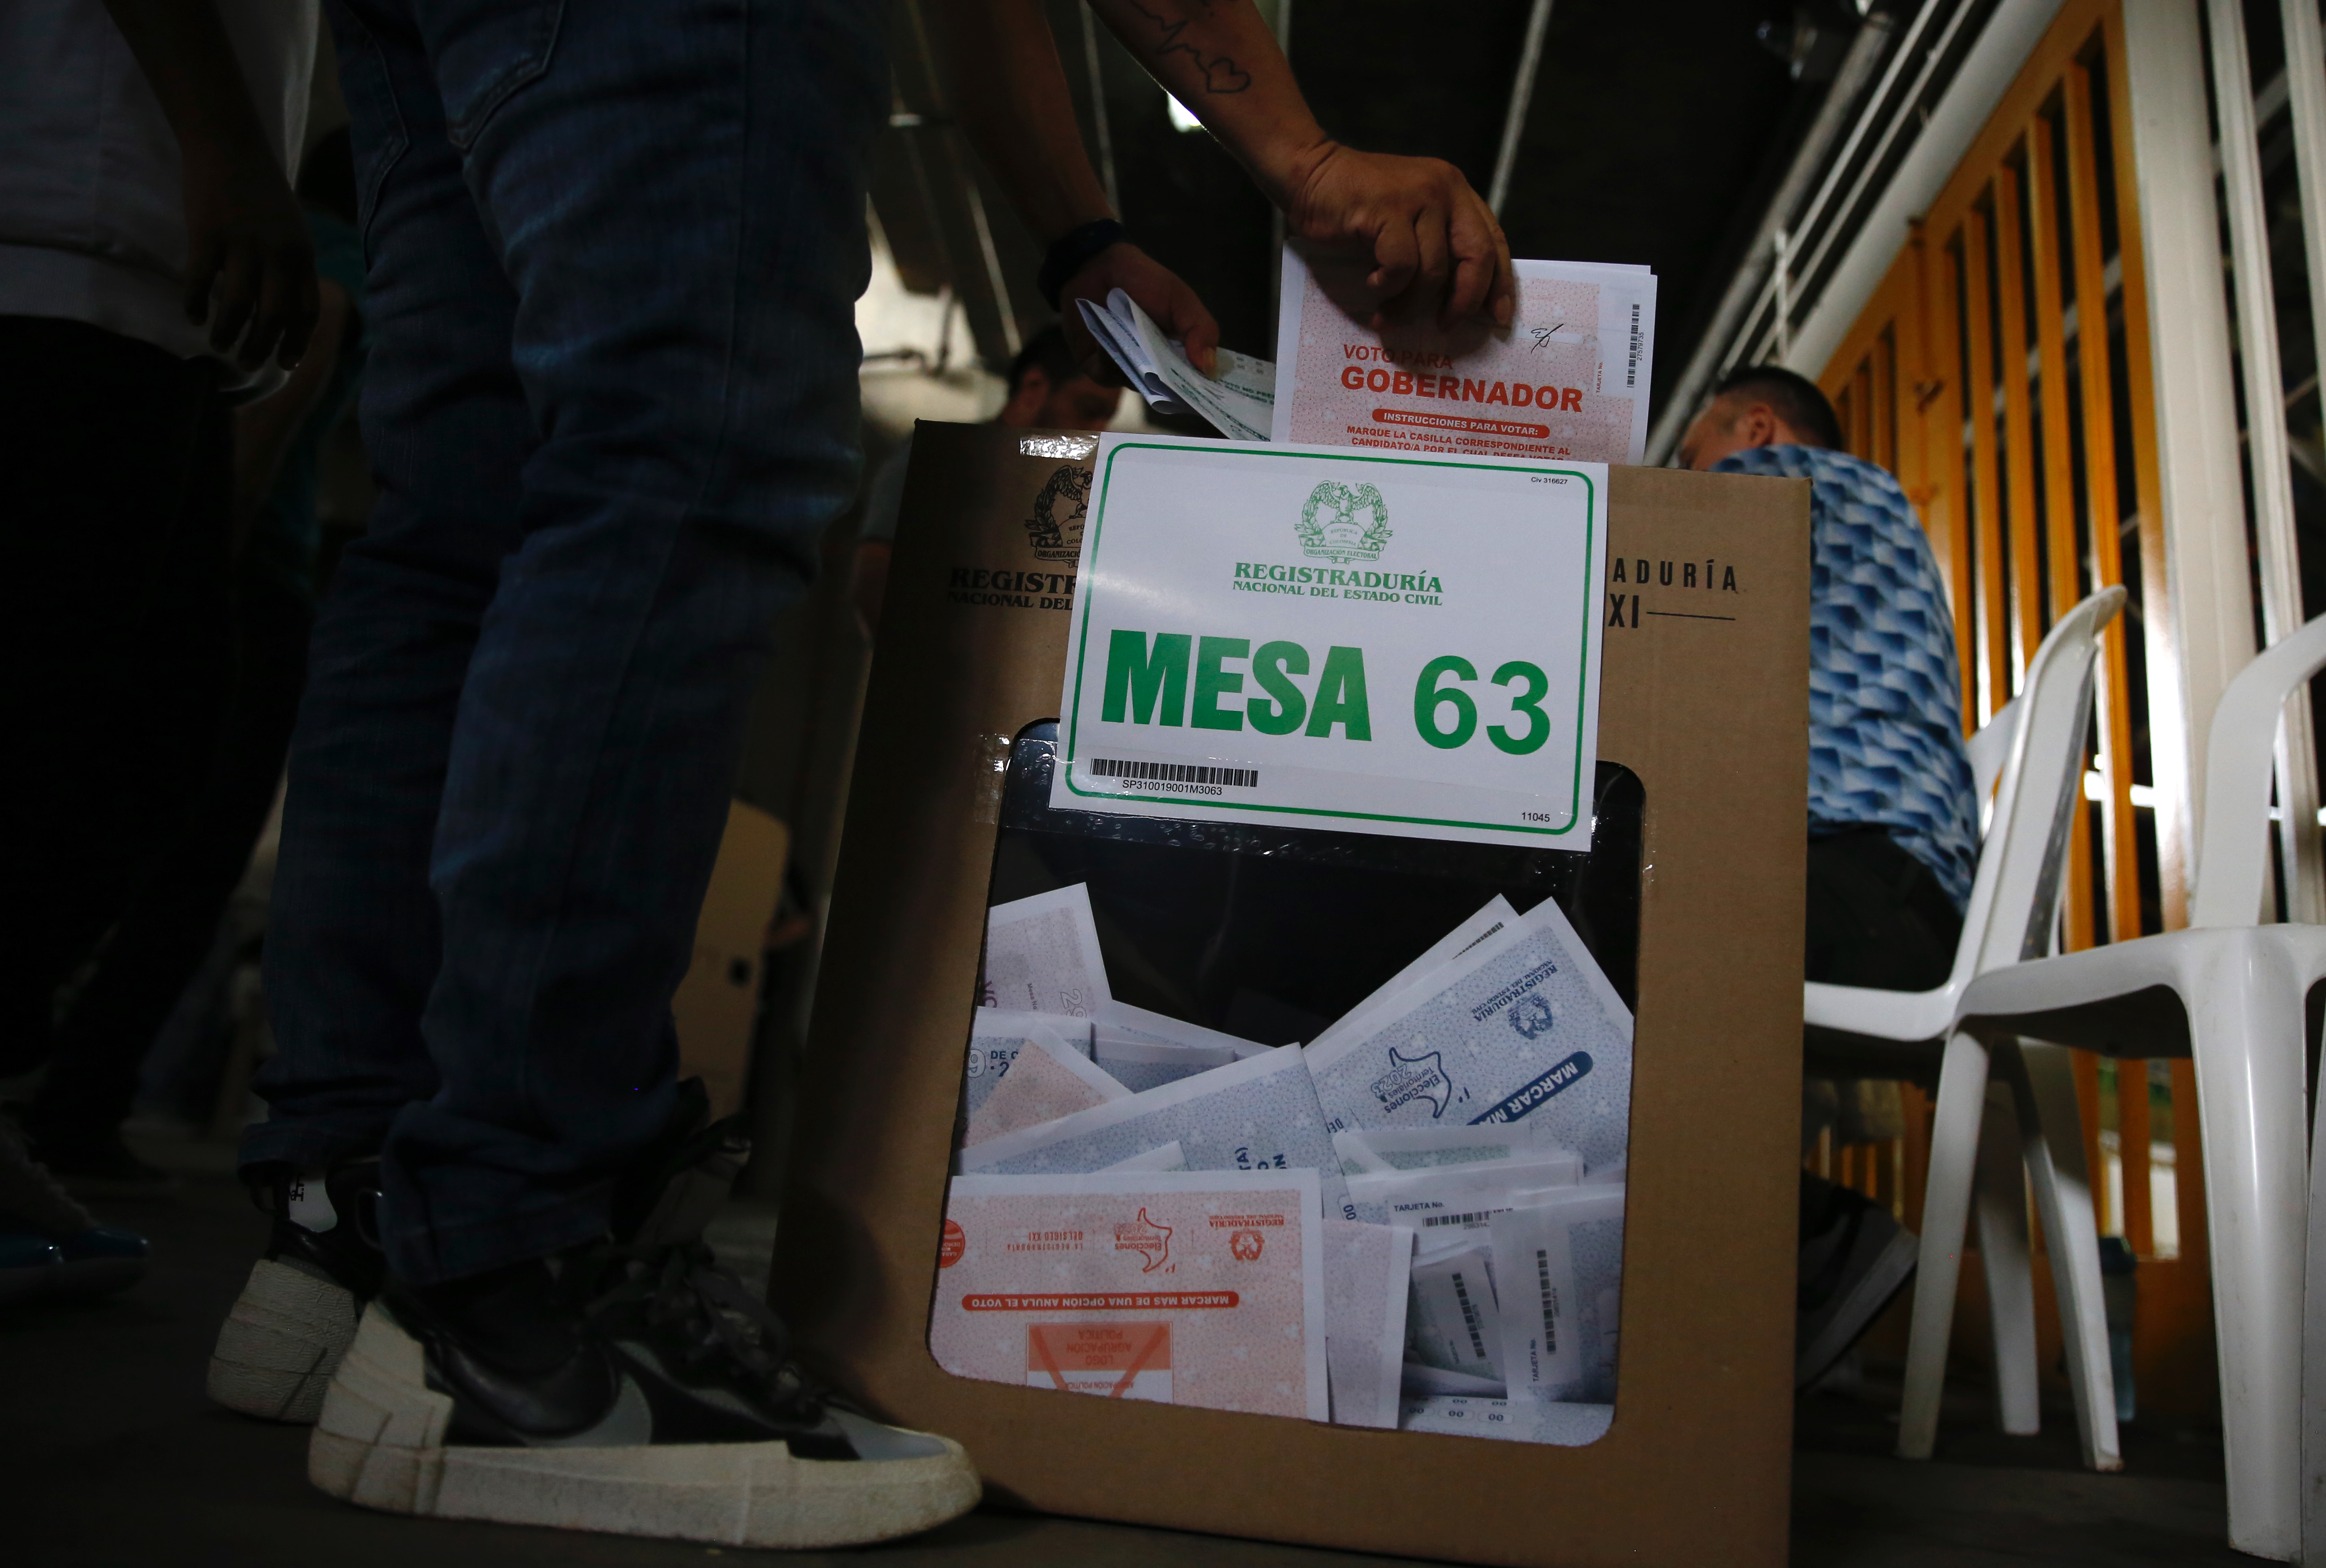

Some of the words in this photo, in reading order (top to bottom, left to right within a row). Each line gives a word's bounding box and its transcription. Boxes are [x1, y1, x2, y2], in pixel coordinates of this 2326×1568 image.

[1344, 344, 1392, 364] VOTO
[1401, 350, 1453, 370] PARA
[1341, 366, 1582, 413] GOBERNADOR
[1383, 413, 1467, 429] INSTRUCCIONES
[1470, 422, 1497, 432] PARA
[1500, 425, 1538, 435] VOTAR:
[1347, 426, 1390, 438] MARQUE
[1394, 430, 1406, 439] LA
[1409, 432, 1452, 444] CASILLA
[1455, 437, 1555, 454] CORRESPONDIENTE
[1557, 446, 1571, 455] AL
[1352, 437, 1419, 451] CANDIDATO/A
[1347, 551, 1377, 559] ELECTORAL
[1234, 562, 1444, 593] REGISTRADURÍA
[1232, 580, 1306, 596] NACIONAL
[1310, 587, 1339, 598] DEL
[1344, 589, 1401, 602] ESTADO
[1405, 594, 1443, 606] CIVIL
[947, 592, 1034, 608] NACIONAL
[1039, 598, 1074, 611] DEL
[1101, 629, 1372, 742] MESA
[1414, 655, 1551, 756] 63
[1122, 779, 1223, 796] SP310019001M3063
[1521, 812, 1550, 823] 11045
[1474, 964, 1558, 1022] REGISTRADURÍA
[991, 1051, 1006, 1059] DE
[1384, 1074, 1441, 1114] Elecciones
[1507, 1062, 1579, 1114] MARCAR
[1394, 1203, 1431, 1212] TARJETA
[1209, 1219, 1284, 1230] REGISTRADURÍA
[1115, 1243, 1162, 1251] Elecciones
[972, 1299, 1002, 1307] VOTO
[1005, 1299, 1018, 1307] EL
[1021, 1298, 1059, 1307] ANULA
[1062, 1298, 1105, 1308] OPCIÓN
[1109, 1297, 1132, 1306] UNA
[1154, 1297, 1178, 1306] MÁS
[1181, 1296, 1228, 1305] MARCAR
[1085, 1355, 1113, 1365] LOGO
[1530, 1352, 1539, 1382] TARJETA
